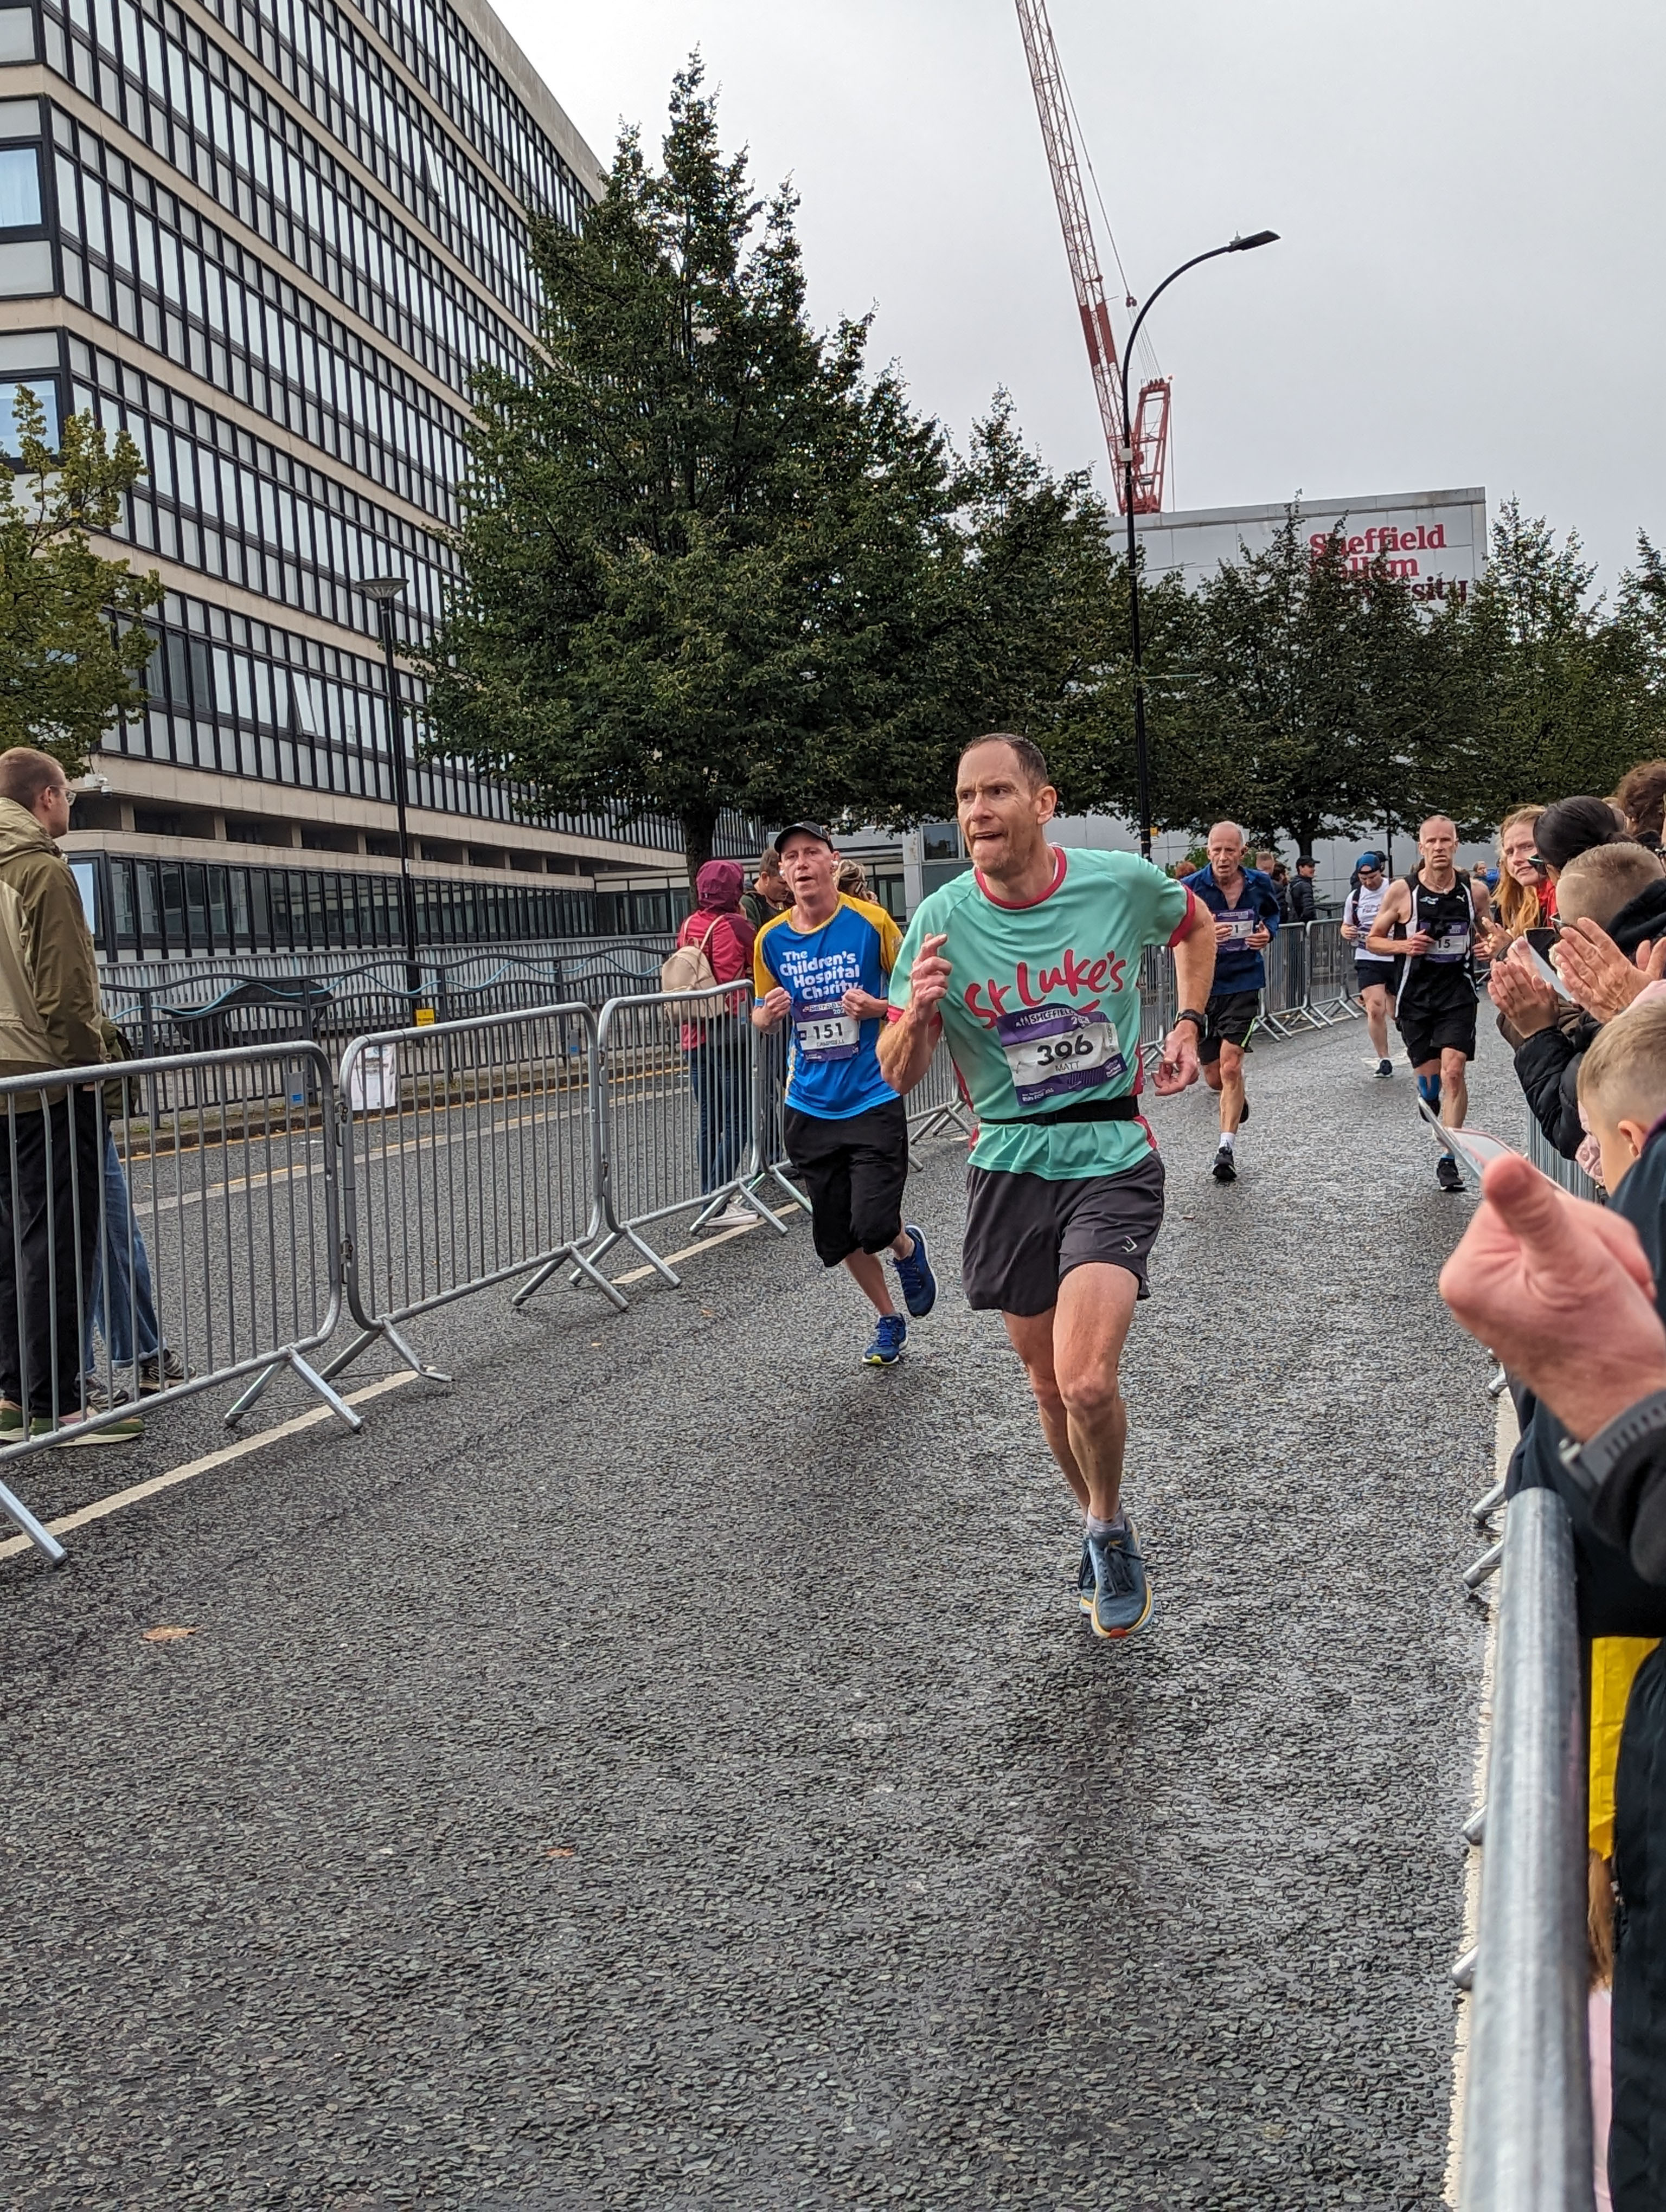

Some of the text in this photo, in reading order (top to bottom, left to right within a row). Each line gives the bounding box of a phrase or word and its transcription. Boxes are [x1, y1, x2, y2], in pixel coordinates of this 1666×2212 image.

[779, 951, 856, 976] Children's
[782, 950, 808, 962] The
[793, 964, 860, 988] Hospital
[802, 980, 859, 1000] Charity
[964, 949, 1126, 1030] St Luke's
[813, 1022, 843, 1040] 151
[1037, 1034, 1094, 1066] 396
[1055, 1060, 1080, 1072] MATT
